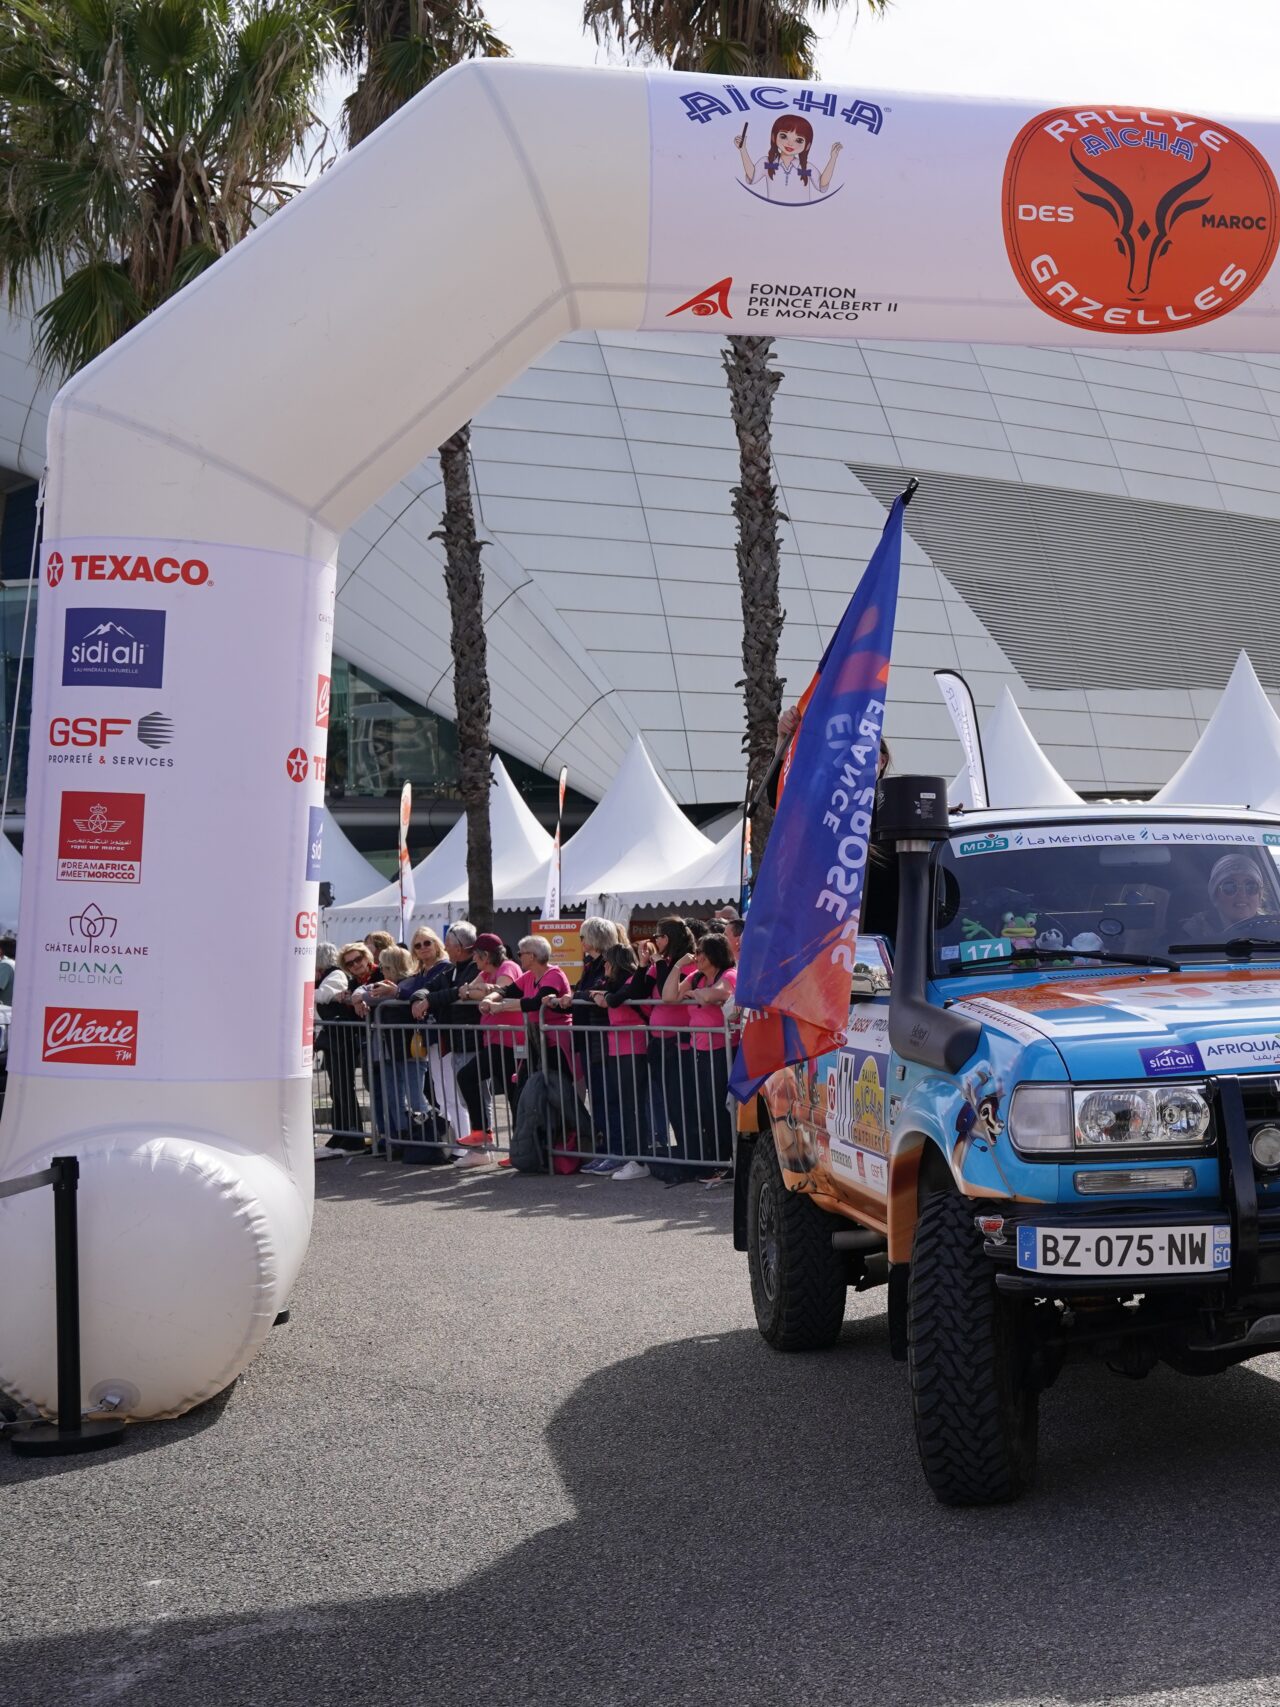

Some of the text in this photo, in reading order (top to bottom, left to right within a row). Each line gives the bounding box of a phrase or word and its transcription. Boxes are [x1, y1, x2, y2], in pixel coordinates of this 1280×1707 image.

[679, 84, 883, 135] AÏCHA
[1043, 110, 1230, 152] RALLYE
[1080, 127, 1195, 162] AÏCHA
[1018, 204, 1075, 223] DES
[1201, 214, 1267, 231] MAROC
[750, 283, 856, 299] FONDATION
[1030, 254, 1247, 325] GAZELLES
[749, 297, 898, 312] PRINCE ALBERT II
[747, 308, 859, 321] DE MONACO
[71, 555, 209, 585] TEXACO
[71, 641, 144, 664] sidi ali
[49, 717, 131, 747] GSF
[48, 753, 174, 767] PROPRETÉ & SERVICES
[963, 839, 1005, 852] MDJS
[1027, 837, 1045, 845] La
[1049, 833, 1135, 844] Méridionale
[1152, 832, 1169, 841] La
[1172, 831, 1256, 842] Méridionale
[61, 861, 135, 871] #DREAMAFRICA
[60, 870, 135, 880] #MEETMOROCCO
[45, 942, 149, 956] CHÂTEAU ROSLANE
[967, 943, 1004, 960] 171
[59, 961, 123, 974] DIANA
[59, 973, 123, 985] HOLDING
[47, 1013, 135, 1048] Chérie
[1150, 1055, 1174, 1068] sidi
[1175, 1054, 1194, 1065] ali
[1024, 1251, 1030, 1261] F
[1042, 1232, 1207, 1267] BZ-075-NW
[1214, 1248, 1231, 1263] 60
